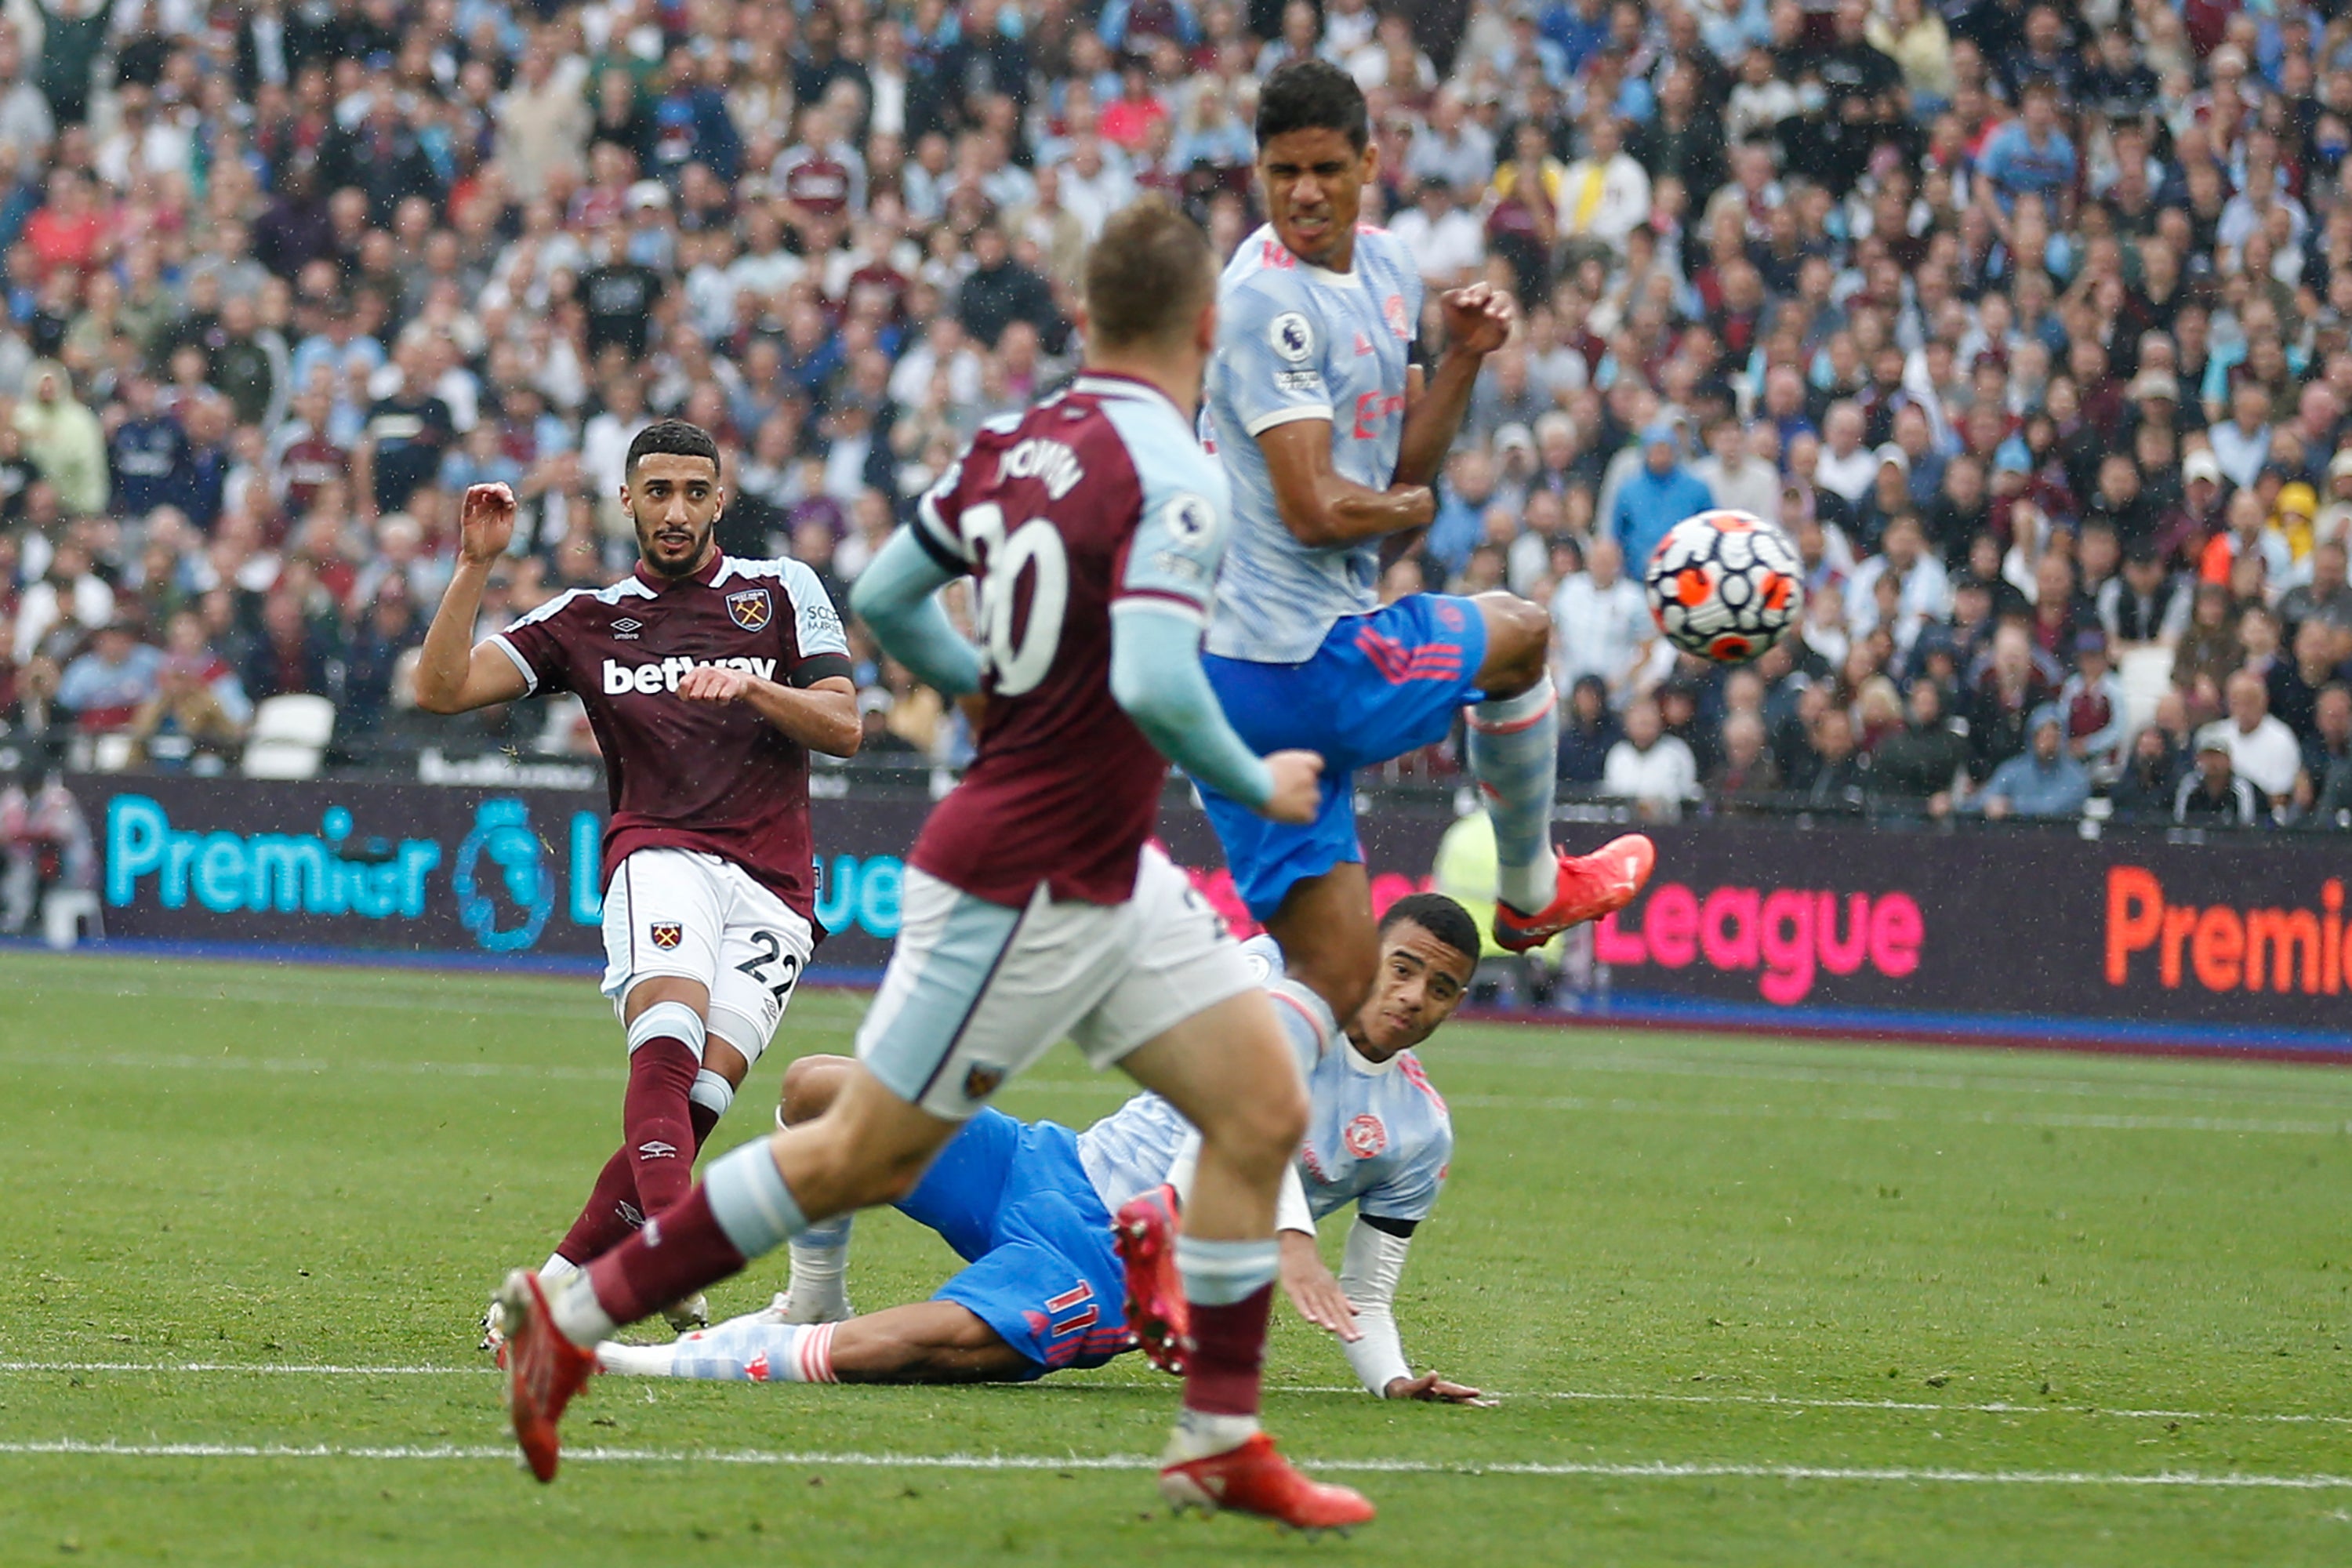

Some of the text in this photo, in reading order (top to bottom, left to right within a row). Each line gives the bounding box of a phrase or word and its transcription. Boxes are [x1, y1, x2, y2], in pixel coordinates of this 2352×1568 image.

[734, 930, 797, 1011] 22
[1593, 881, 1926, 1007] League
[2104, 865, 2352, 996] Premi
[1044, 1278, 1099, 1338] 11
